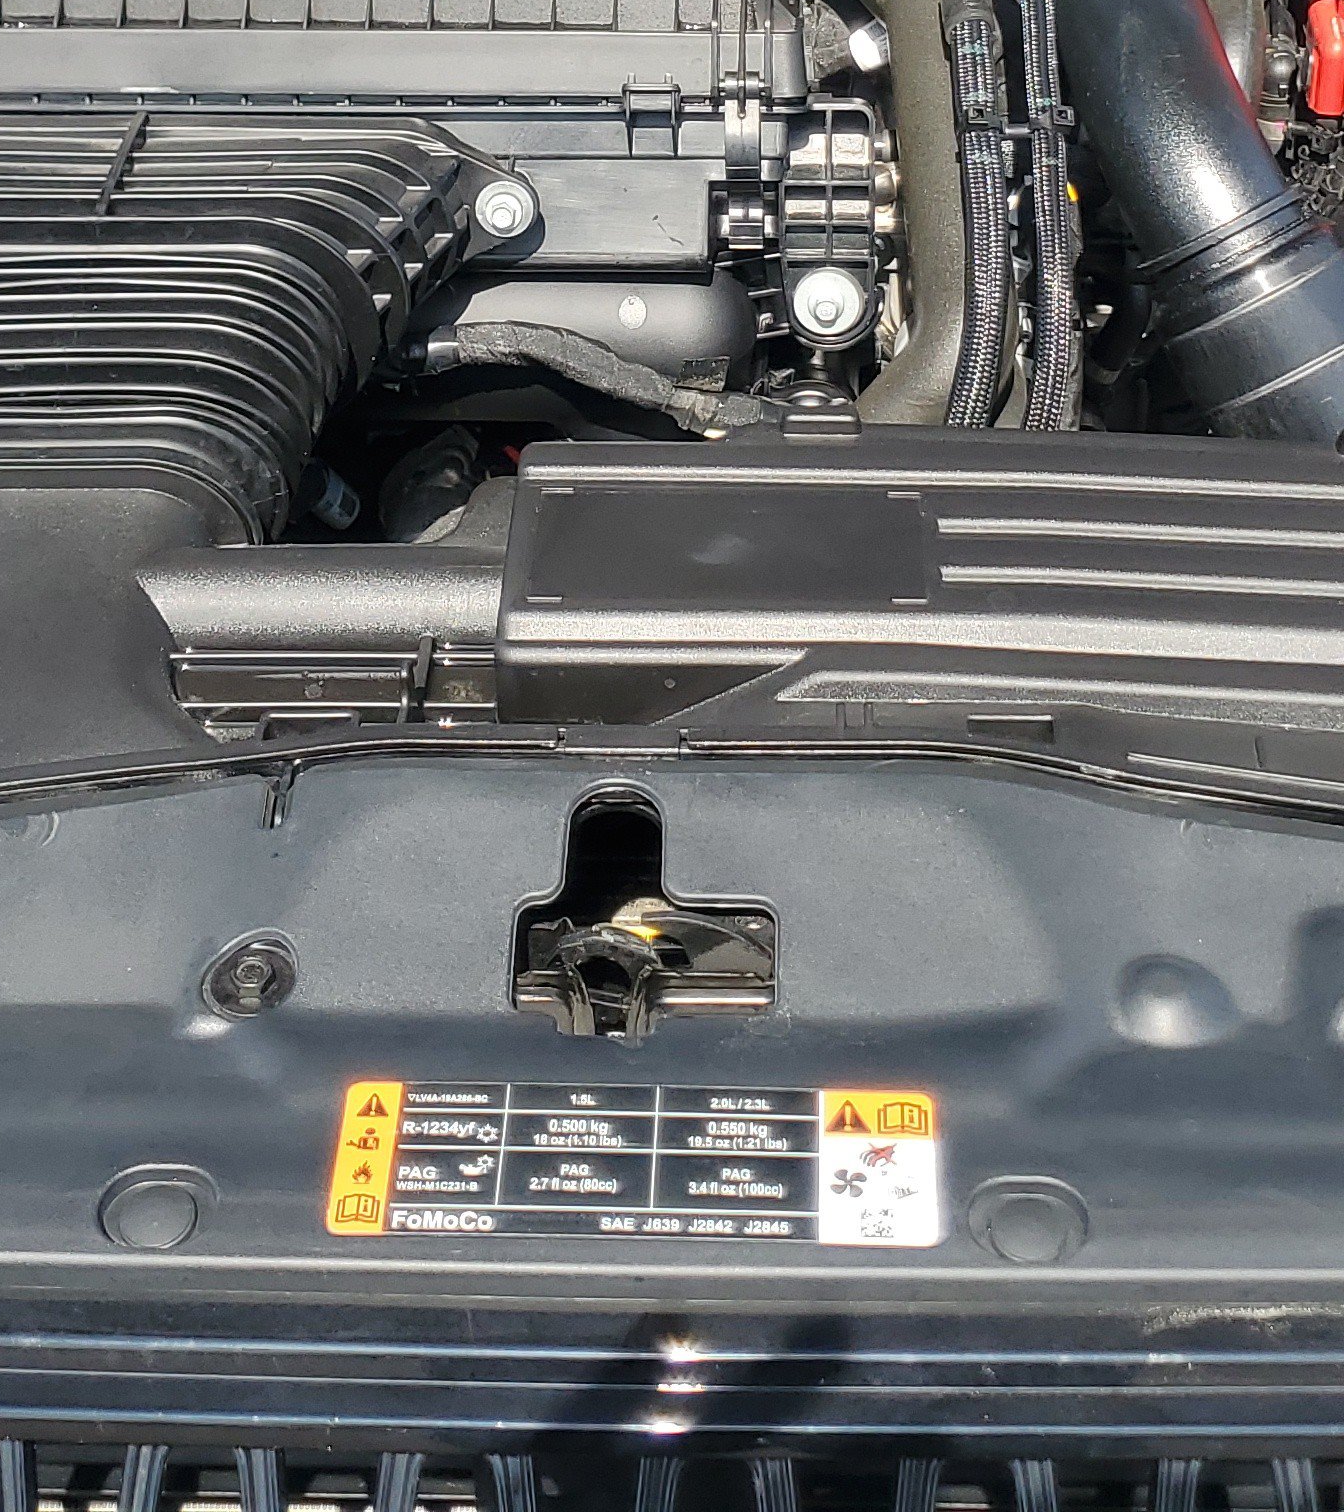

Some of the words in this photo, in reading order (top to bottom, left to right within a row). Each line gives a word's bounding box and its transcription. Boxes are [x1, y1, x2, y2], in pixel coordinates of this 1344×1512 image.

[710, 1098, 736, 1110] 2.0L
[744, 1099, 771, 1111] 2.3L
[403, 1121, 476, 1138] R-1234yf
[549, 1119, 587, 1133] 0.500
[590, 1120, 609, 1135] kg
[708, 1121, 746, 1135] 0.550
[749, 1122, 768, 1138] kg
[550, 1137, 565, 1146] oz
[599, 1136, 622, 1148] lbs)
[715, 1139, 730, 1148] oz
[732, 1137, 761, 1150] (1.21
[764, 1138, 787, 1151] lbs)
[398, 1166, 437, 1180] PAG
[560, 1164, 590, 1176] PAG
[722, 1168, 751, 1180] PAG
[529, 1177, 549, 1191] 2.7
[550, 1178, 560, 1191] fl
[562, 1181, 577, 1191] oz
[688, 1181, 708, 1195] 3.4
[709, 1182, 718, 1194] fl
[720, 1185, 737, 1195] oz
[738, 1183, 783, 1199] (100cc)
[391, 1210, 494, 1231] FoMoCo
[601, 1217, 635, 1231] SAE
[642, 1218, 680, 1232] J639
[689, 1219, 733, 1233] J2842
[743, 1220, 789, 1234] J2845
